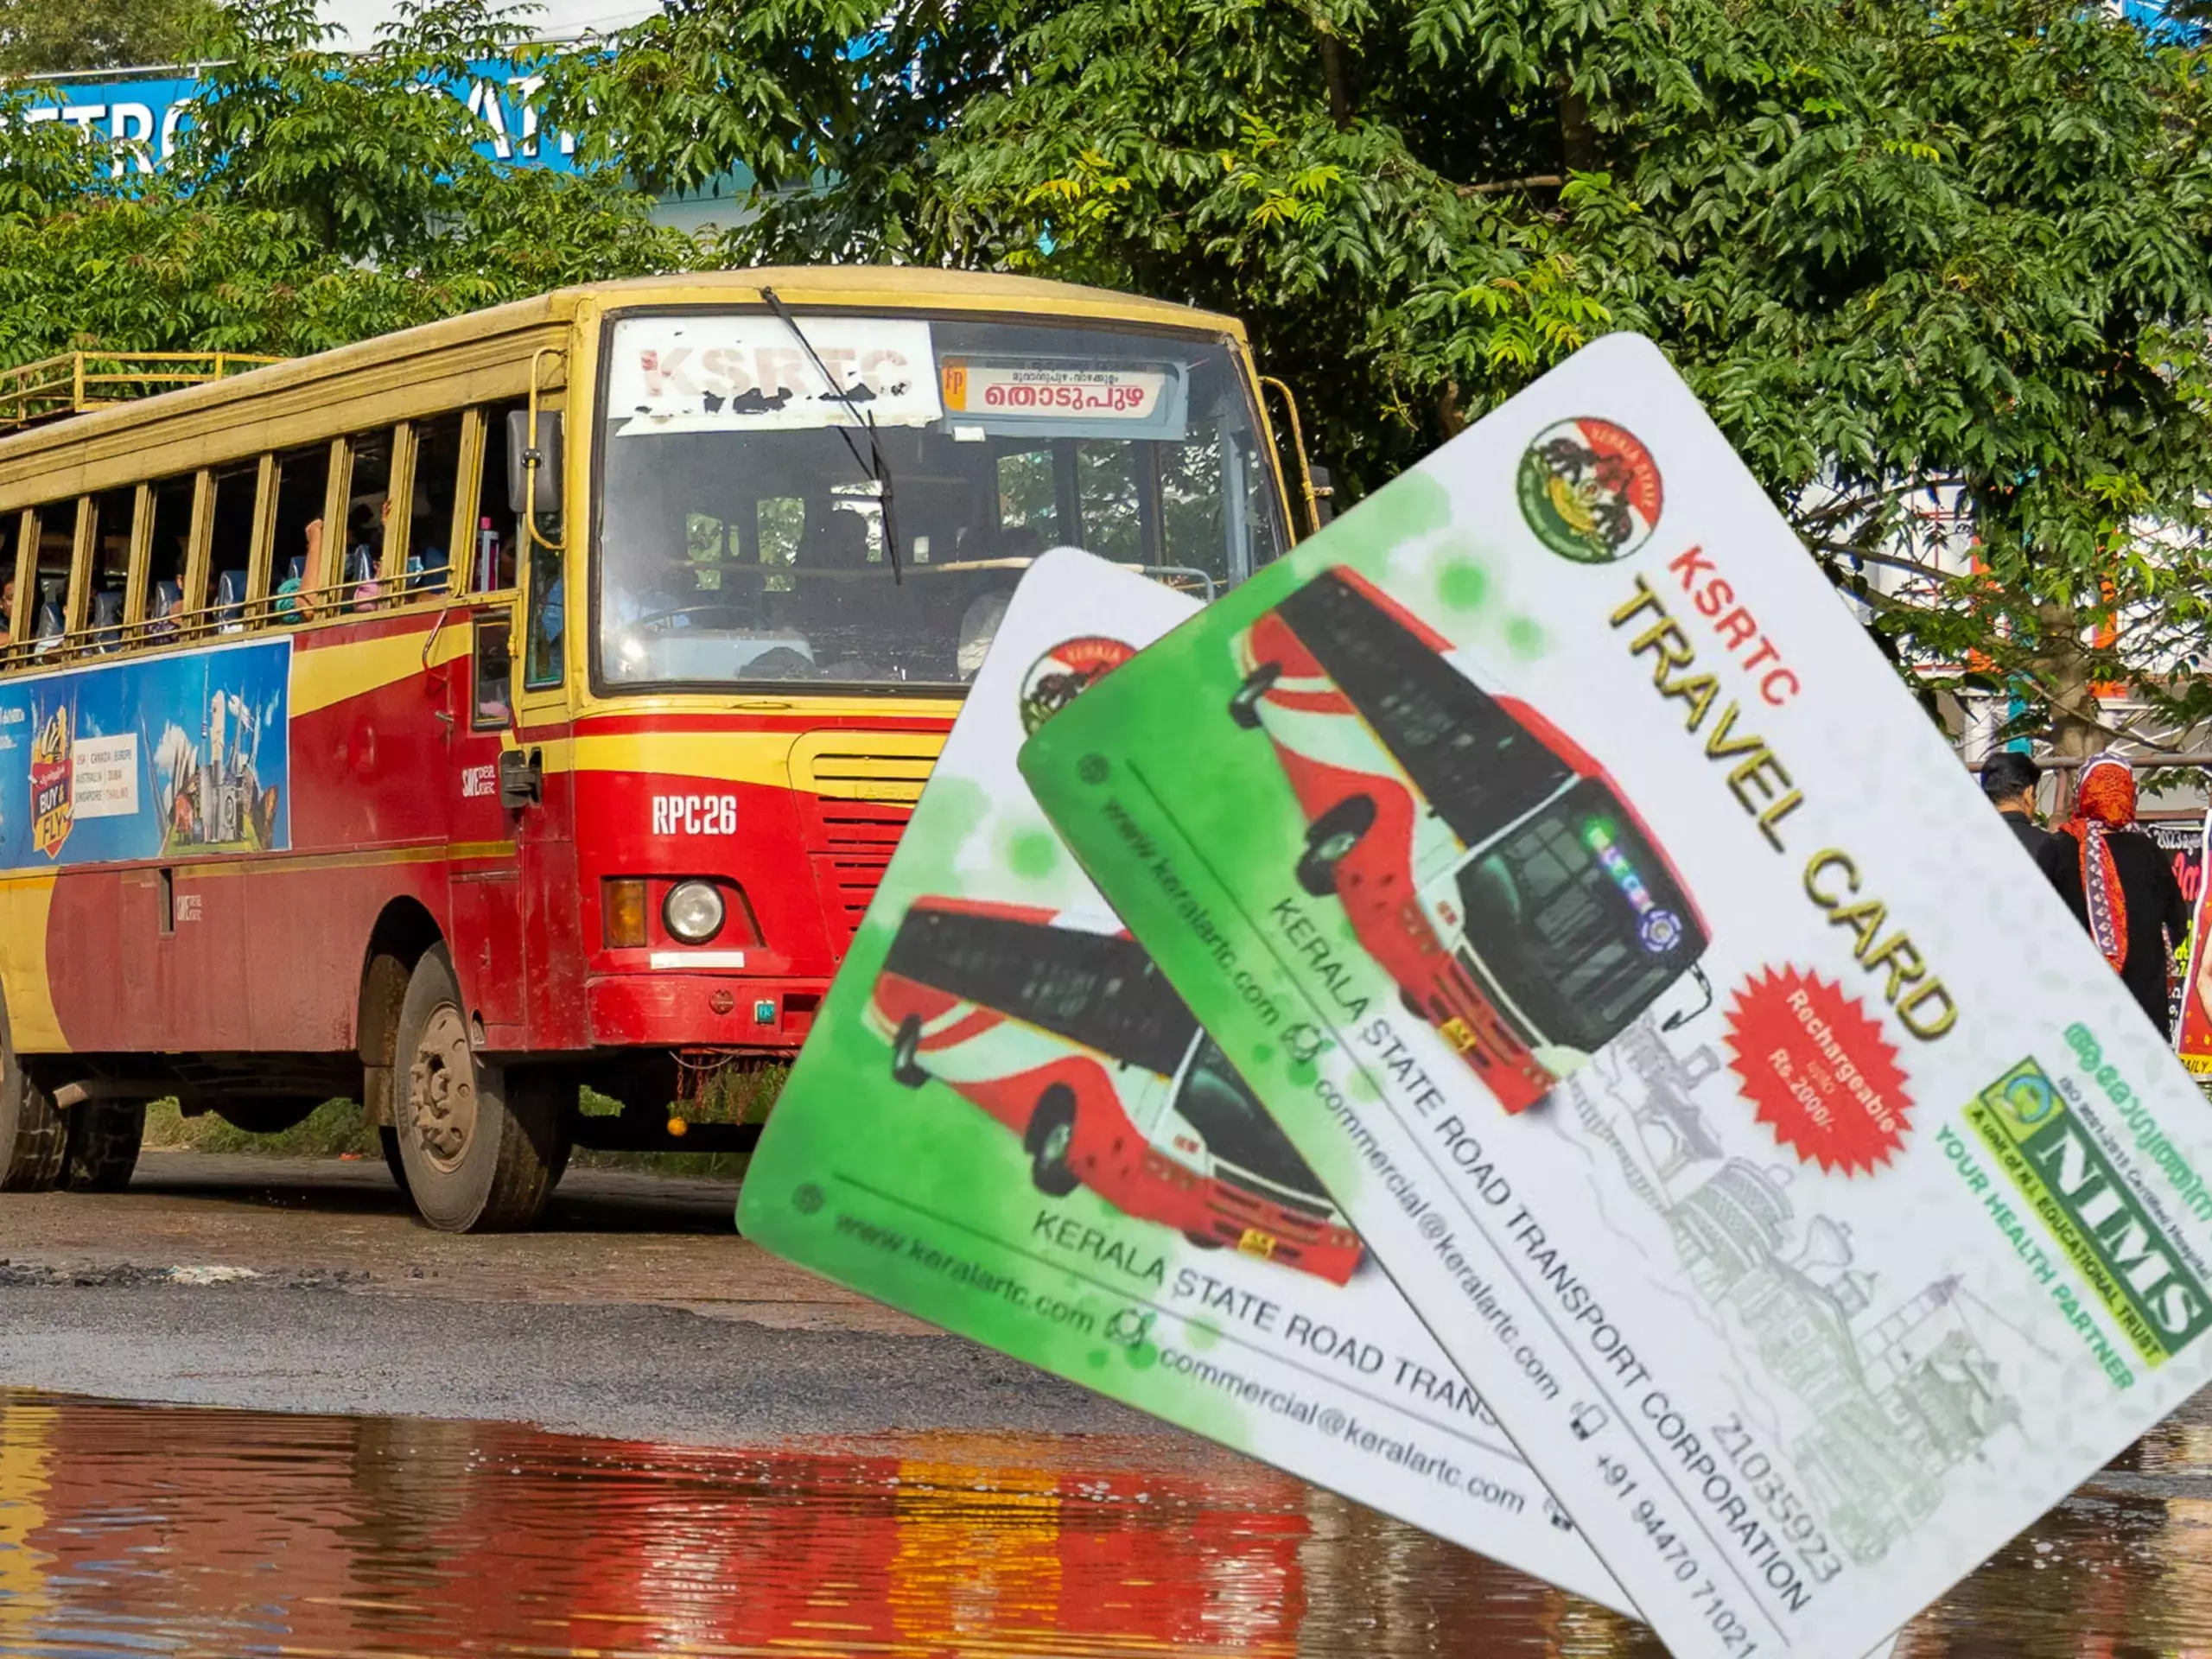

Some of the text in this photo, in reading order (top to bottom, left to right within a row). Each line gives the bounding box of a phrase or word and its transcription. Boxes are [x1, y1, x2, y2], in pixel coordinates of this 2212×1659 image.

[640, 347, 912, 399] KSRTC
[985, 385, 1145, 411] തൊടുപുഴ
[1669, 546, 1799, 705] KSRTC
[39, 785, 59, 815] BUY
[42, 811, 63, 846] FLY
[1610, 577, 1806, 852] TRAVEL
[1803, 851, 1955, 1041] CARD
[1786, 988, 1904, 1132] Rechargeable
[1033, 1210, 1164, 1285] KERALA
[1174, 1268, 1279, 1329] STATE
[1285, 1314, 1383, 1373] ROAD
[1271, 897, 1810, 1611] KERALA STATE ROAD TRANSPORT CORPORATION
[1316, 1080, 1559, 1399] commercial@keralartc.com
[1936, 1124, 2134, 1389] YOUR HEALTH PARTNER
[1971, 1109, 1984, 1122] A
[2036, 1194, 2123, 1306] EDUCATIONAL
[2116, 1305, 2163, 1357] TRUST
[2038, 1130, 2200, 1332] NIMS
[1160, 1349, 1524, 1512] commercial@keralartc.com
[1711, 1413, 1842, 1583] 21035923
[1594, 1455, 1757, 1659] +91 94470 71021
